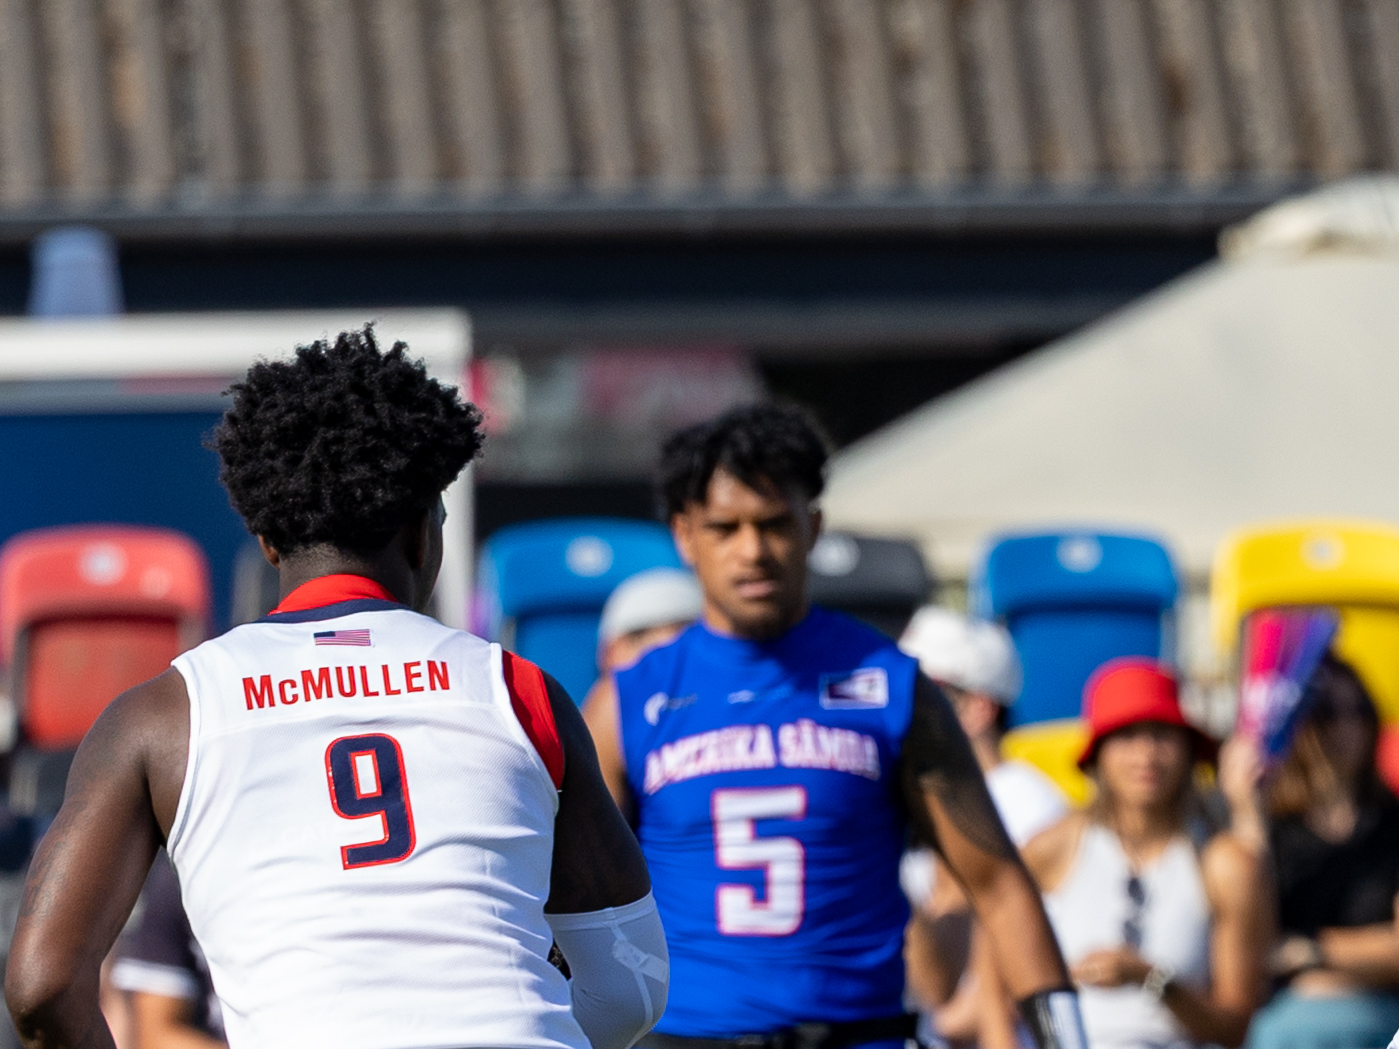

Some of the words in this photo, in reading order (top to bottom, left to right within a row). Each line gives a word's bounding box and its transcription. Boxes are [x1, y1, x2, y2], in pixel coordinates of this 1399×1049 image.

[241, 660, 451, 711] McMULLEN
[324, 732, 417, 871] 9
[710, 784, 808, 938] 5
